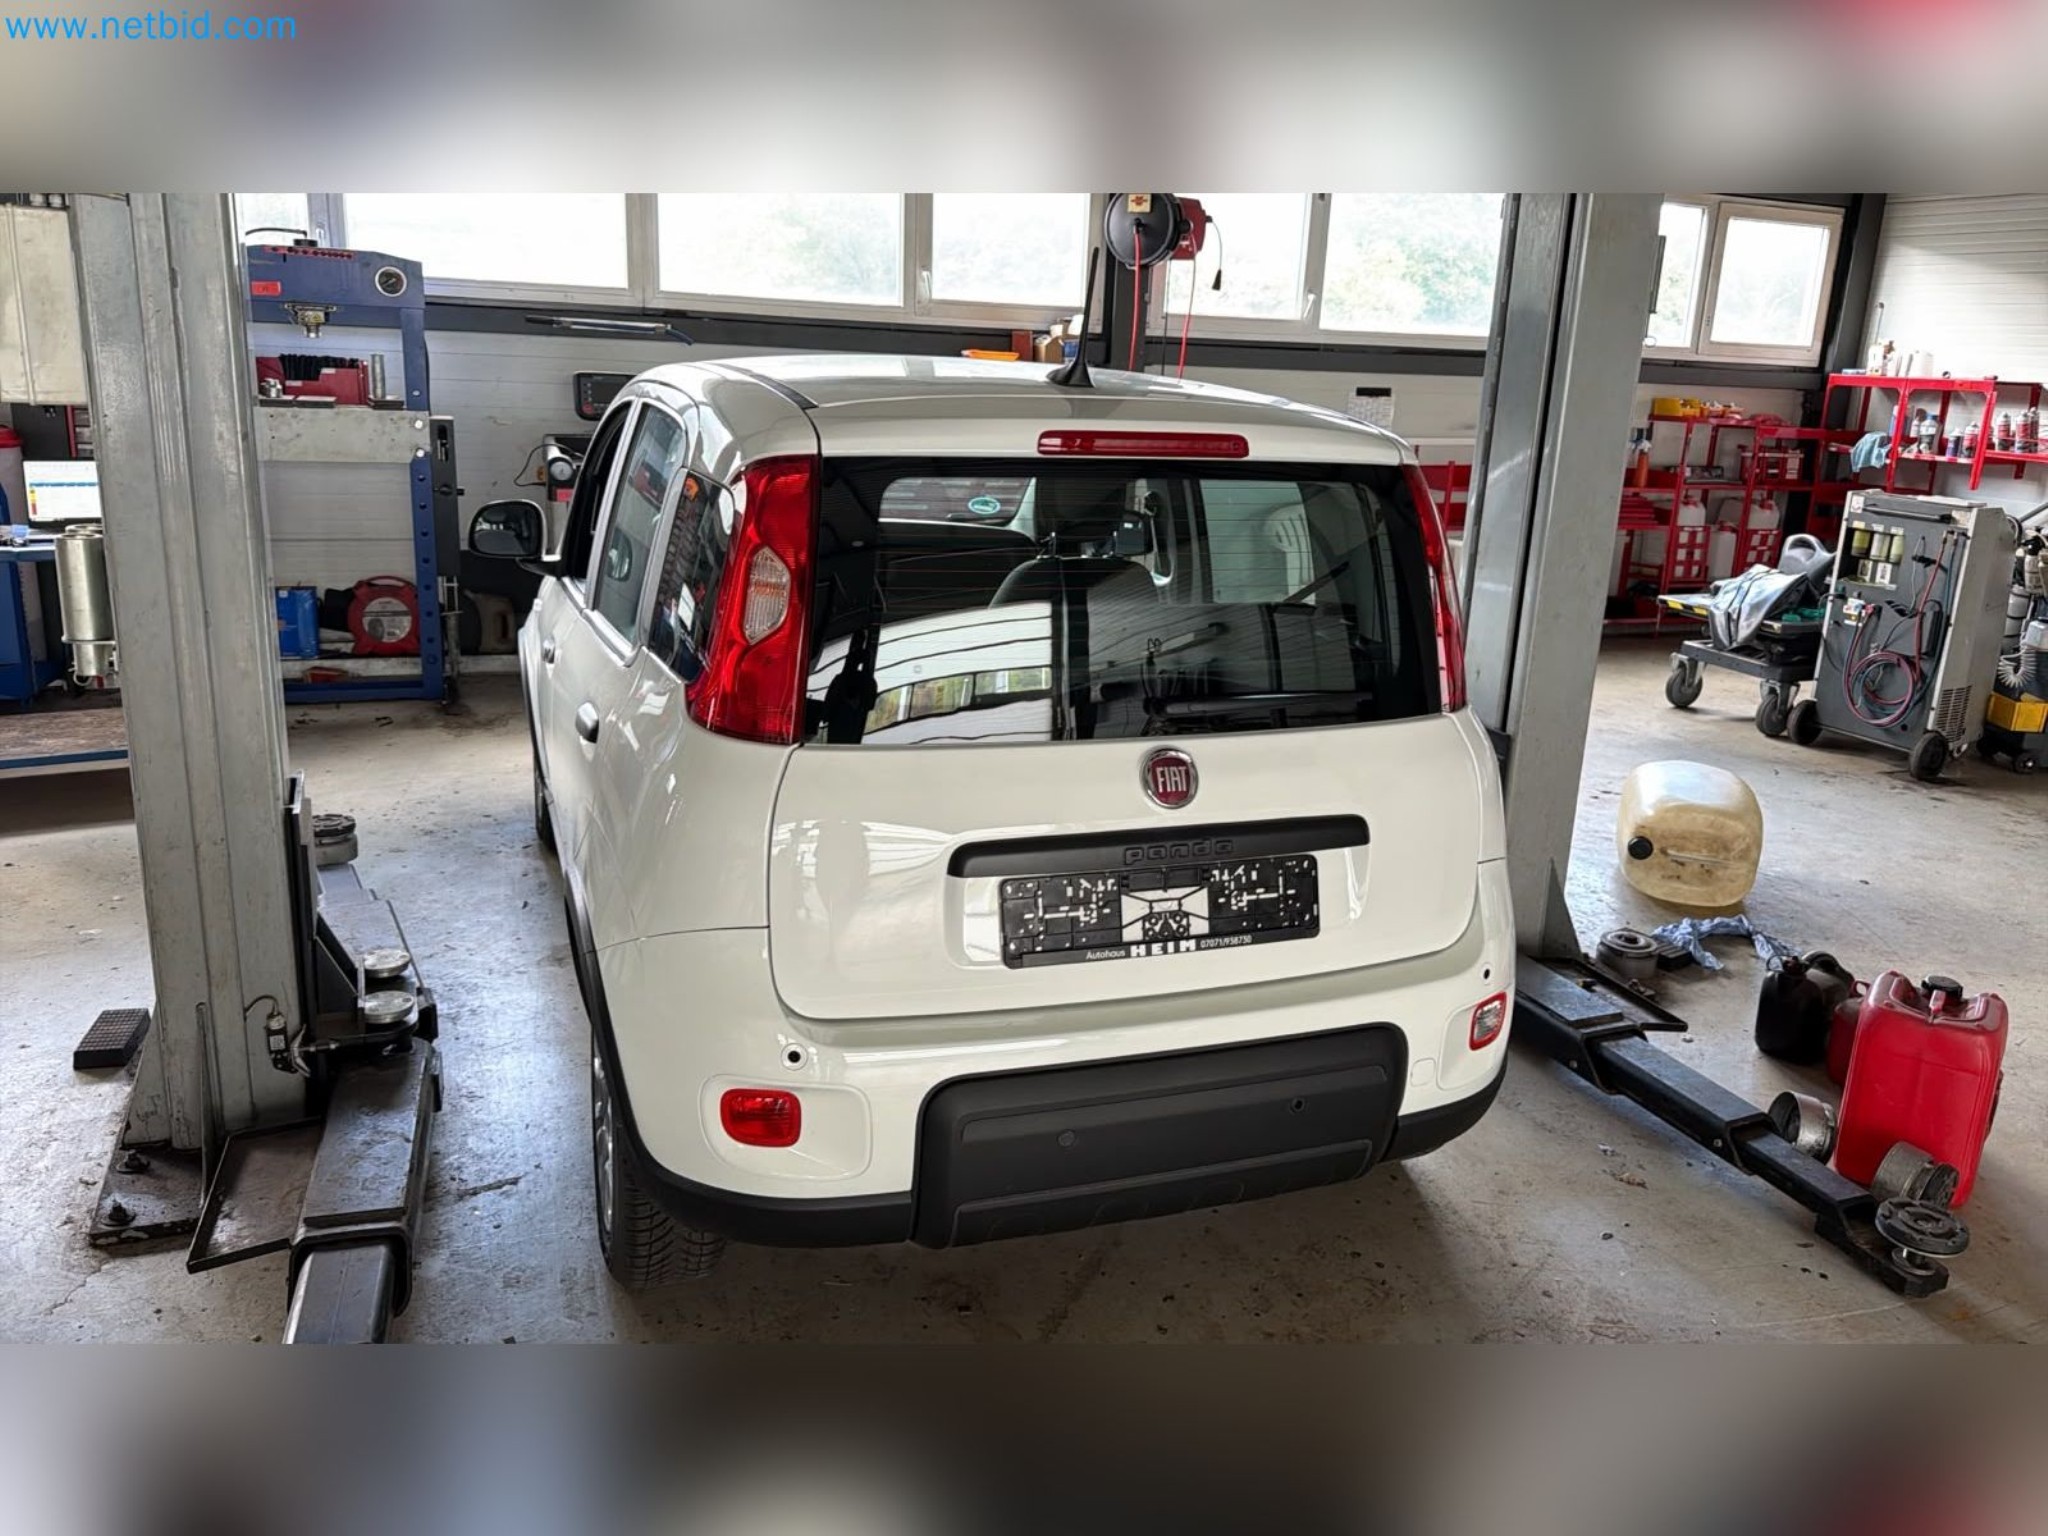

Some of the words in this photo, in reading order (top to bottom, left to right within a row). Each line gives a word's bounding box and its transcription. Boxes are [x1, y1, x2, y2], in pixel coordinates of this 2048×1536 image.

[1155, 765, 1189, 793] FIAT
[1085, 949, 1126, 961] Autohaus
[1130, 939, 1197, 957] HEIM
